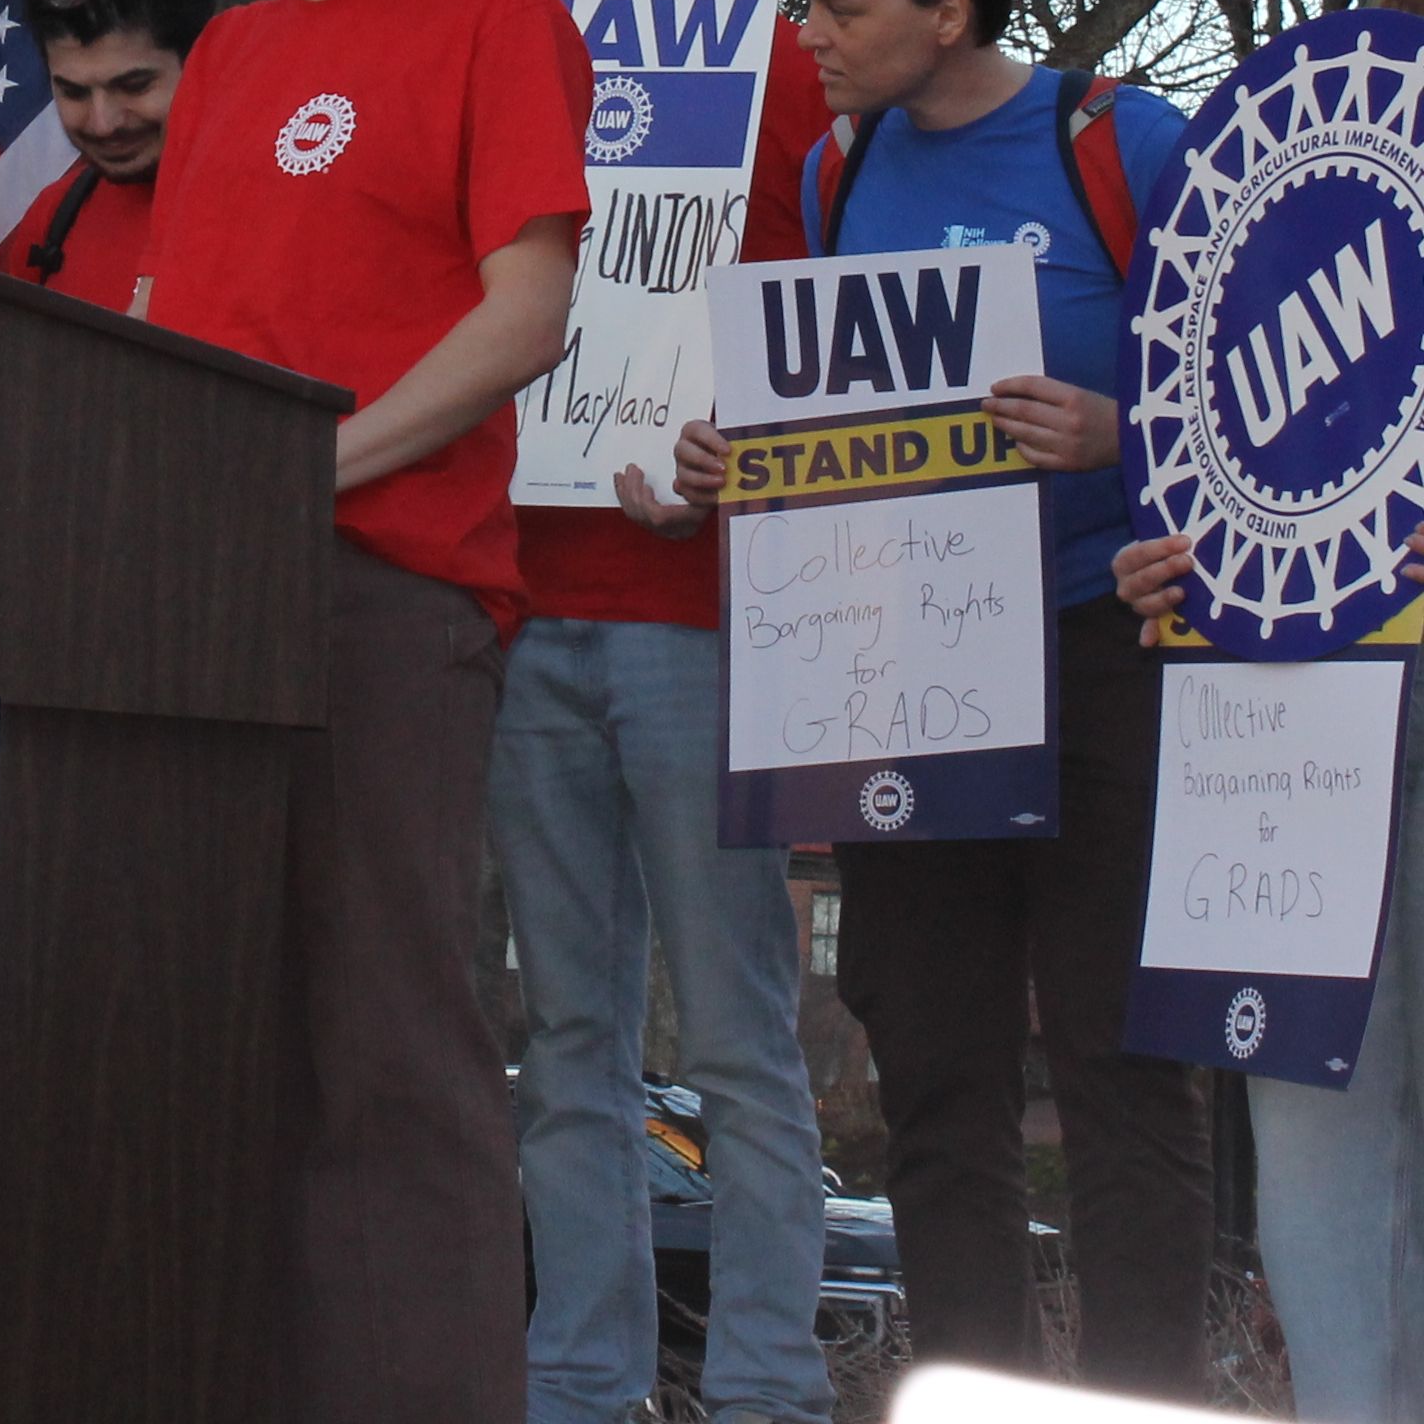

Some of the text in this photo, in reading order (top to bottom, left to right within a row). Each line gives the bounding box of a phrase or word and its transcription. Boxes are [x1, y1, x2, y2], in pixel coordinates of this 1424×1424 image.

[595, 109, 632, 130] UAW
[1232, 130, 1339, 215] AGRICULTURAL
[598, 188, 748, 294] UNIONS
[963, 228, 986, 238] NIH
[1206, 218, 1230, 265] AND
[761, 265, 981, 399] UAW
[1184, 274, 1207, 398] AEROSPACE
[1226, 218, 1395, 448] UAW
[540, 327, 680, 458] Maryland
[736, 430, 930, 492] STAND
[747, 516, 975, 595] Collective
[1246, 512, 1297, 539] UNITED
[745, 582, 1005, 662] Bargaining Rights
[847, 653, 896, 684] for
[783, 685, 991, 759] GRADS
[875, 794, 899, 809] UAW
[1184, 760, 1361, 803] Bargaining Rights
[1259, 811, 1279, 844] for
[1184, 852, 1324, 922] GRADS
